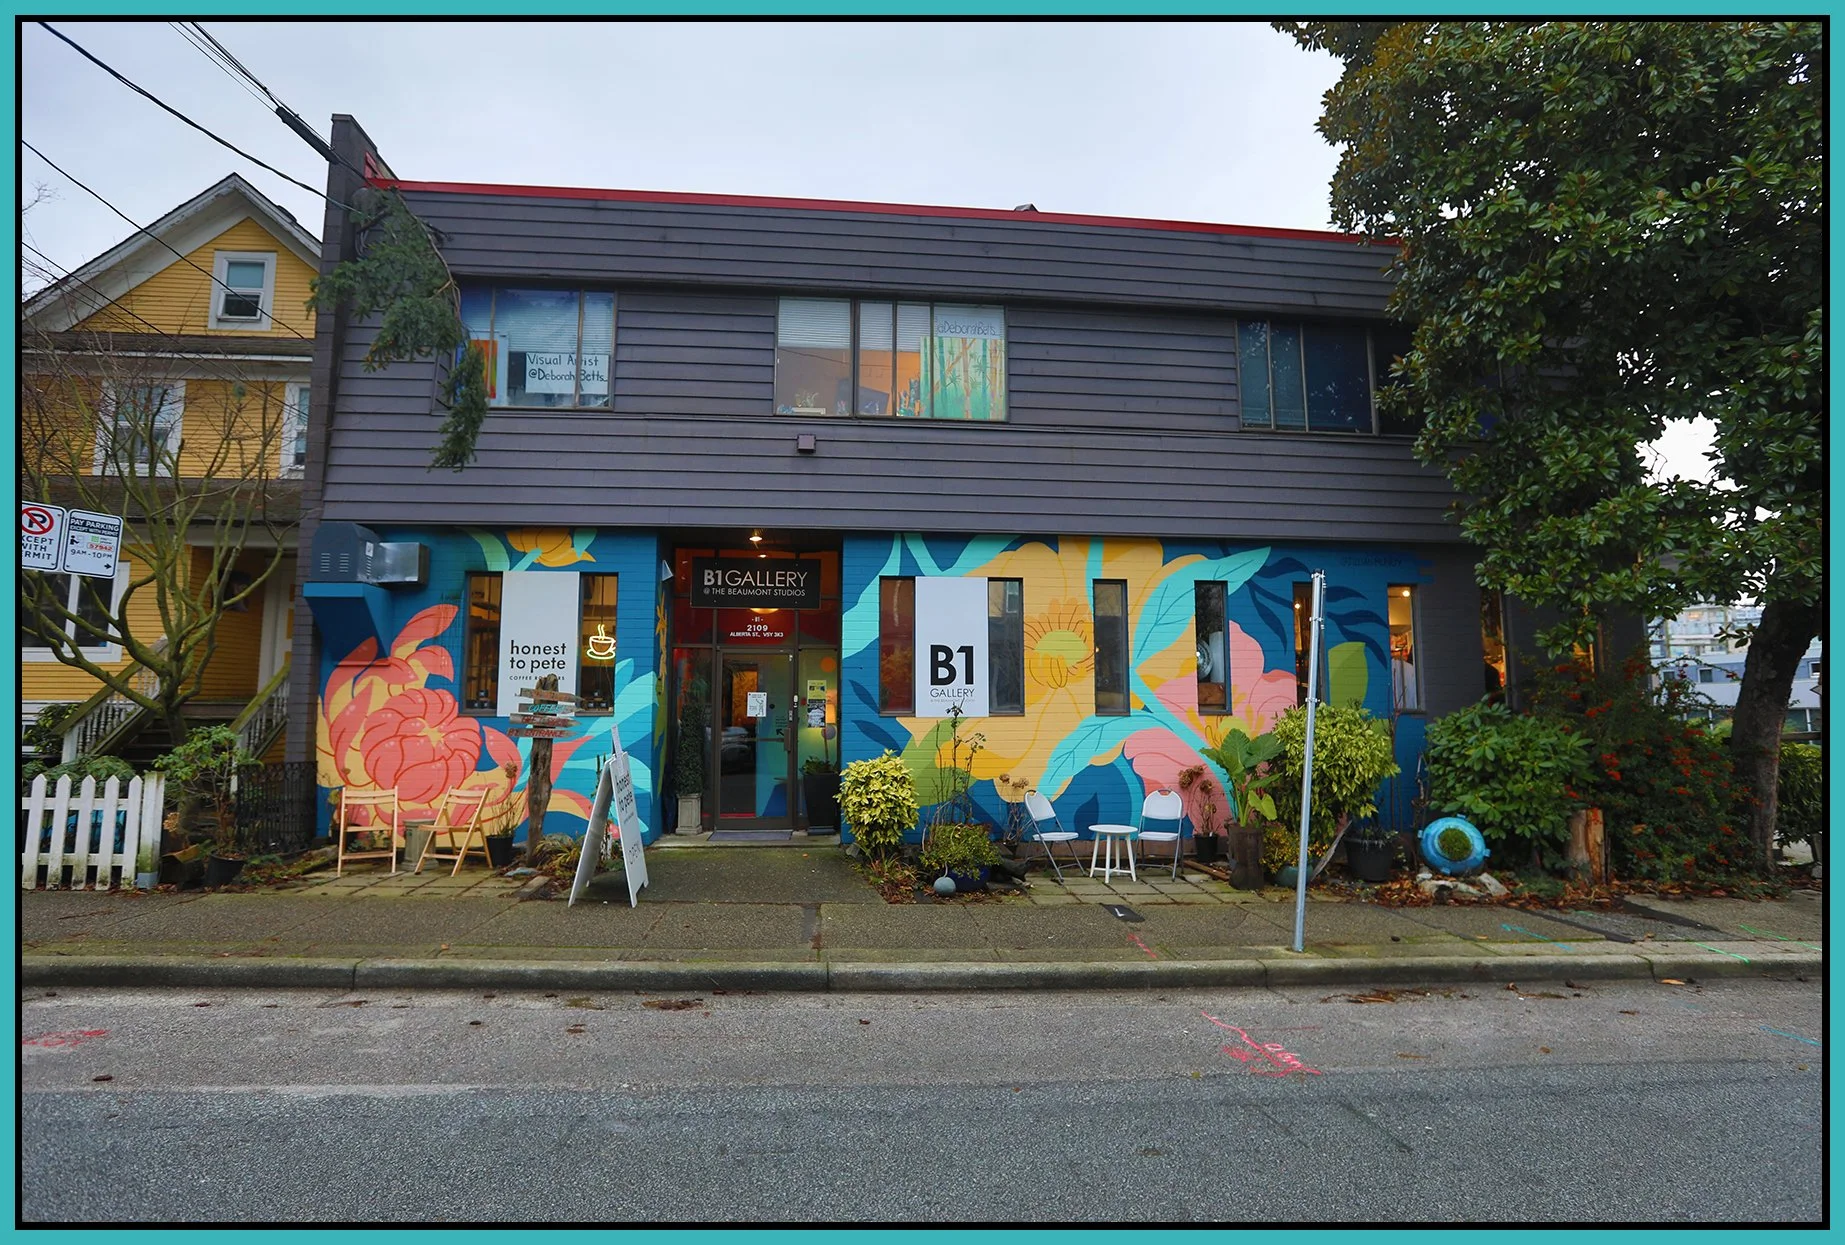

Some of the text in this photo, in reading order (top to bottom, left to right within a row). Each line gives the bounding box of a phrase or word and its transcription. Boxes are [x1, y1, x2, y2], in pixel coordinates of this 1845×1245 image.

[527, 353, 562, 365] Visual
[70, 518, 119, 532] PAY PARKING
[22, 535, 54, 545] XCEPT
[22, 550, 52, 560] RMIT
[704, 569, 808, 587] B1 GALLERY
[712, 587, 726, 595] THE
[727, 588, 772, 596] BEAUMONT
[773, 588, 806, 597] STUDIOS
[746, 624, 769, 632] 2109
[510, 639, 567, 655] honest
[509, 656, 566, 674] to pete
[930, 644, 974, 686] B1
[929, 688, 975, 698] GALLERY
